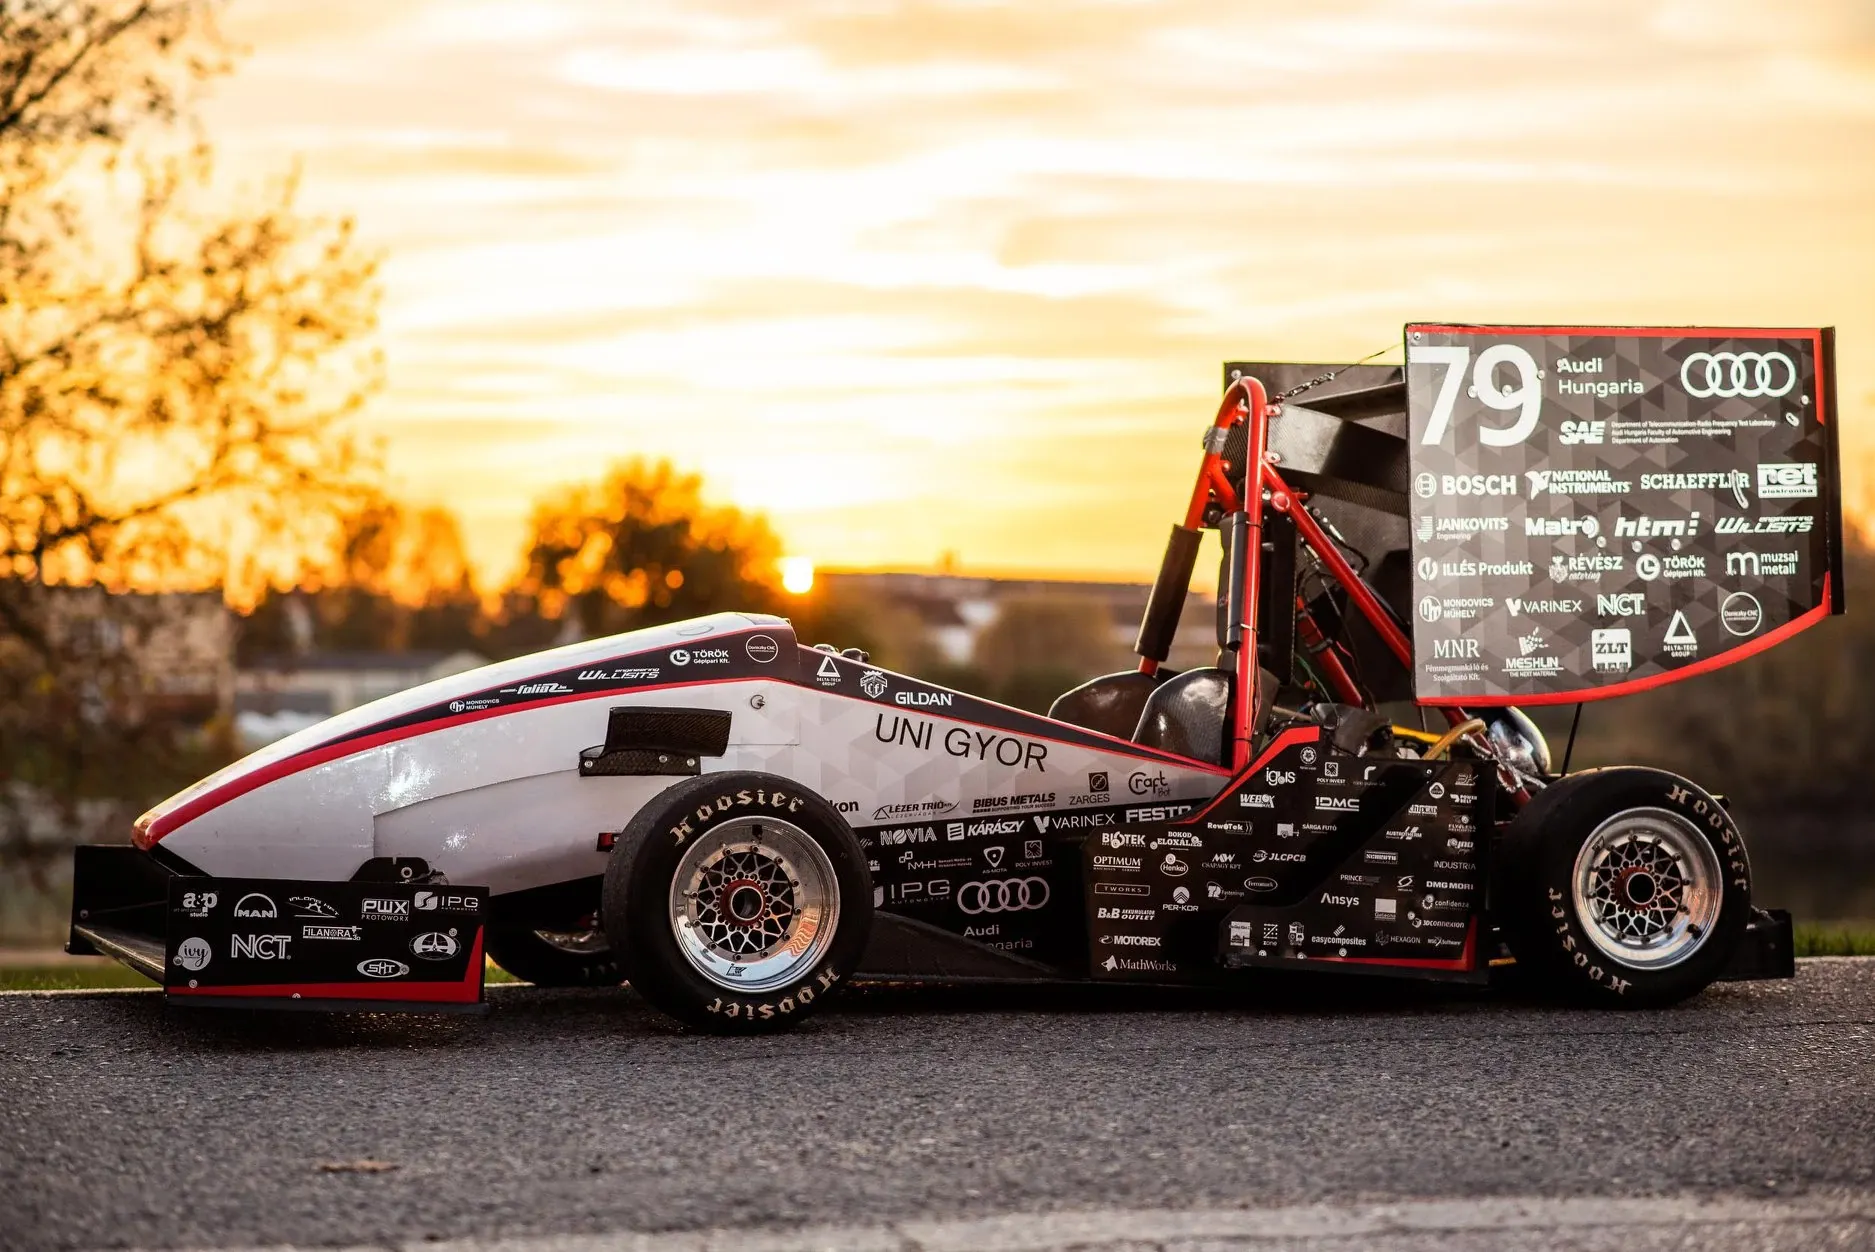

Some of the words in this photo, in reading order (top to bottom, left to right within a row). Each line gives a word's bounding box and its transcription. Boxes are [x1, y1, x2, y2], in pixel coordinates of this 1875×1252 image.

[1557, 357, 1603, 374] Audi
[1558, 378, 1645, 398] Hungaria
[1409, 343, 1542, 447] 79
[1559, 420, 1606, 445] SAE
[1552, 470, 1611, 482] NATIONAL
[1442, 475, 1518, 496] BOSCH
[1550, 481, 1632, 494] INSTRUMENTS
[1436, 517, 1509, 531] JANKOVITS
[1437, 533, 1471, 541] Engineering
[1443, 560, 1476, 576] ILLÉS
[1479, 561, 1533, 576] Produkt
[1569, 553, 1624, 571] RÉVÉSZ
[1663, 555, 1705, 568] TÖRÖK
[1761, 563, 1796, 576] metall
[1569, 571, 1602, 583] catering
[1444, 598, 1494, 608] MONDOVICS
[1523, 599, 1583, 613] VARINEX
[693, 648, 729, 658] TÖRÖK
[1433, 639, 1480, 659] MNR
[1595, 642, 1628, 654] ZLT
[1663, 644, 1698, 652] DELTA-TECH
[1506, 656, 1559, 669] MESHLIN
[1533, 669, 1557, 677] MATERIAL
[466, 698, 500, 706] MONDOVICS
[895, 691, 953, 706] GILDAN
[875, 713, 933, 750] UNI
[944, 727, 1048, 773] GYOR
[1128, 771, 1168, 796] Craft
[1158, 788, 1171, 797] Bot
[973, 796, 1009, 809] BIBUS
[1010, 792, 1057, 806] METALS
[1069, 793, 1110, 806] ZARGES
[889, 803, 919, 814] LÉZER
[920, 801, 944, 811] TRIÓ
[991, 804, 1021, 812] SUPPORTING
[669, 789, 804, 847] Hoosier
[1052, 813, 1116, 830] VARINEX
[967, 819, 1025, 837] KÁRÁSZY
[880, 827, 938, 846] NOVIA
[1666, 784, 1748, 891] Hoosier
[1031, 859, 1053, 867] INVEST
[1093, 855, 1141, 867] OPTIMUM
[1269, 852, 1307, 862] JLCPCB
[1163, 863, 1187, 873] Henkel
[1340, 873, 1364, 882] PRINCE
[890, 879, 950, 900] IPG
[1426, 880, 1448, 889] DMG
[1449, 881, 1475, 890] MORI
[441, 895, 479, 908] IPG
[1320, 892, 1360, 908] Ansys
[1434, 900, 1470, 909] confidenza
[237, 909, 273, 918] MAN
[363, 900, 409, 915] PWX
[1097, 907, 1121, 919] B&B
[1162, 903, 1199, 912] PER-KOR
[361, 914, 410, 922] PROTOWORX
[963, 924, 1000, 937] Audi
[1114, 935, 1162, 947] MOTOREX
[1311, 935, 1367, 947] easycomposites
[1390, 935, 1421, 944] HEXAGON
[1548, 887, 1633, 996] Hoosier
[184, 944, 209, 967] ivy
[367, 961, 396, 976] SHT
[1119, 958, 1177, 971] MathWorks
[706, 965, 841, 1021] Hoosier
